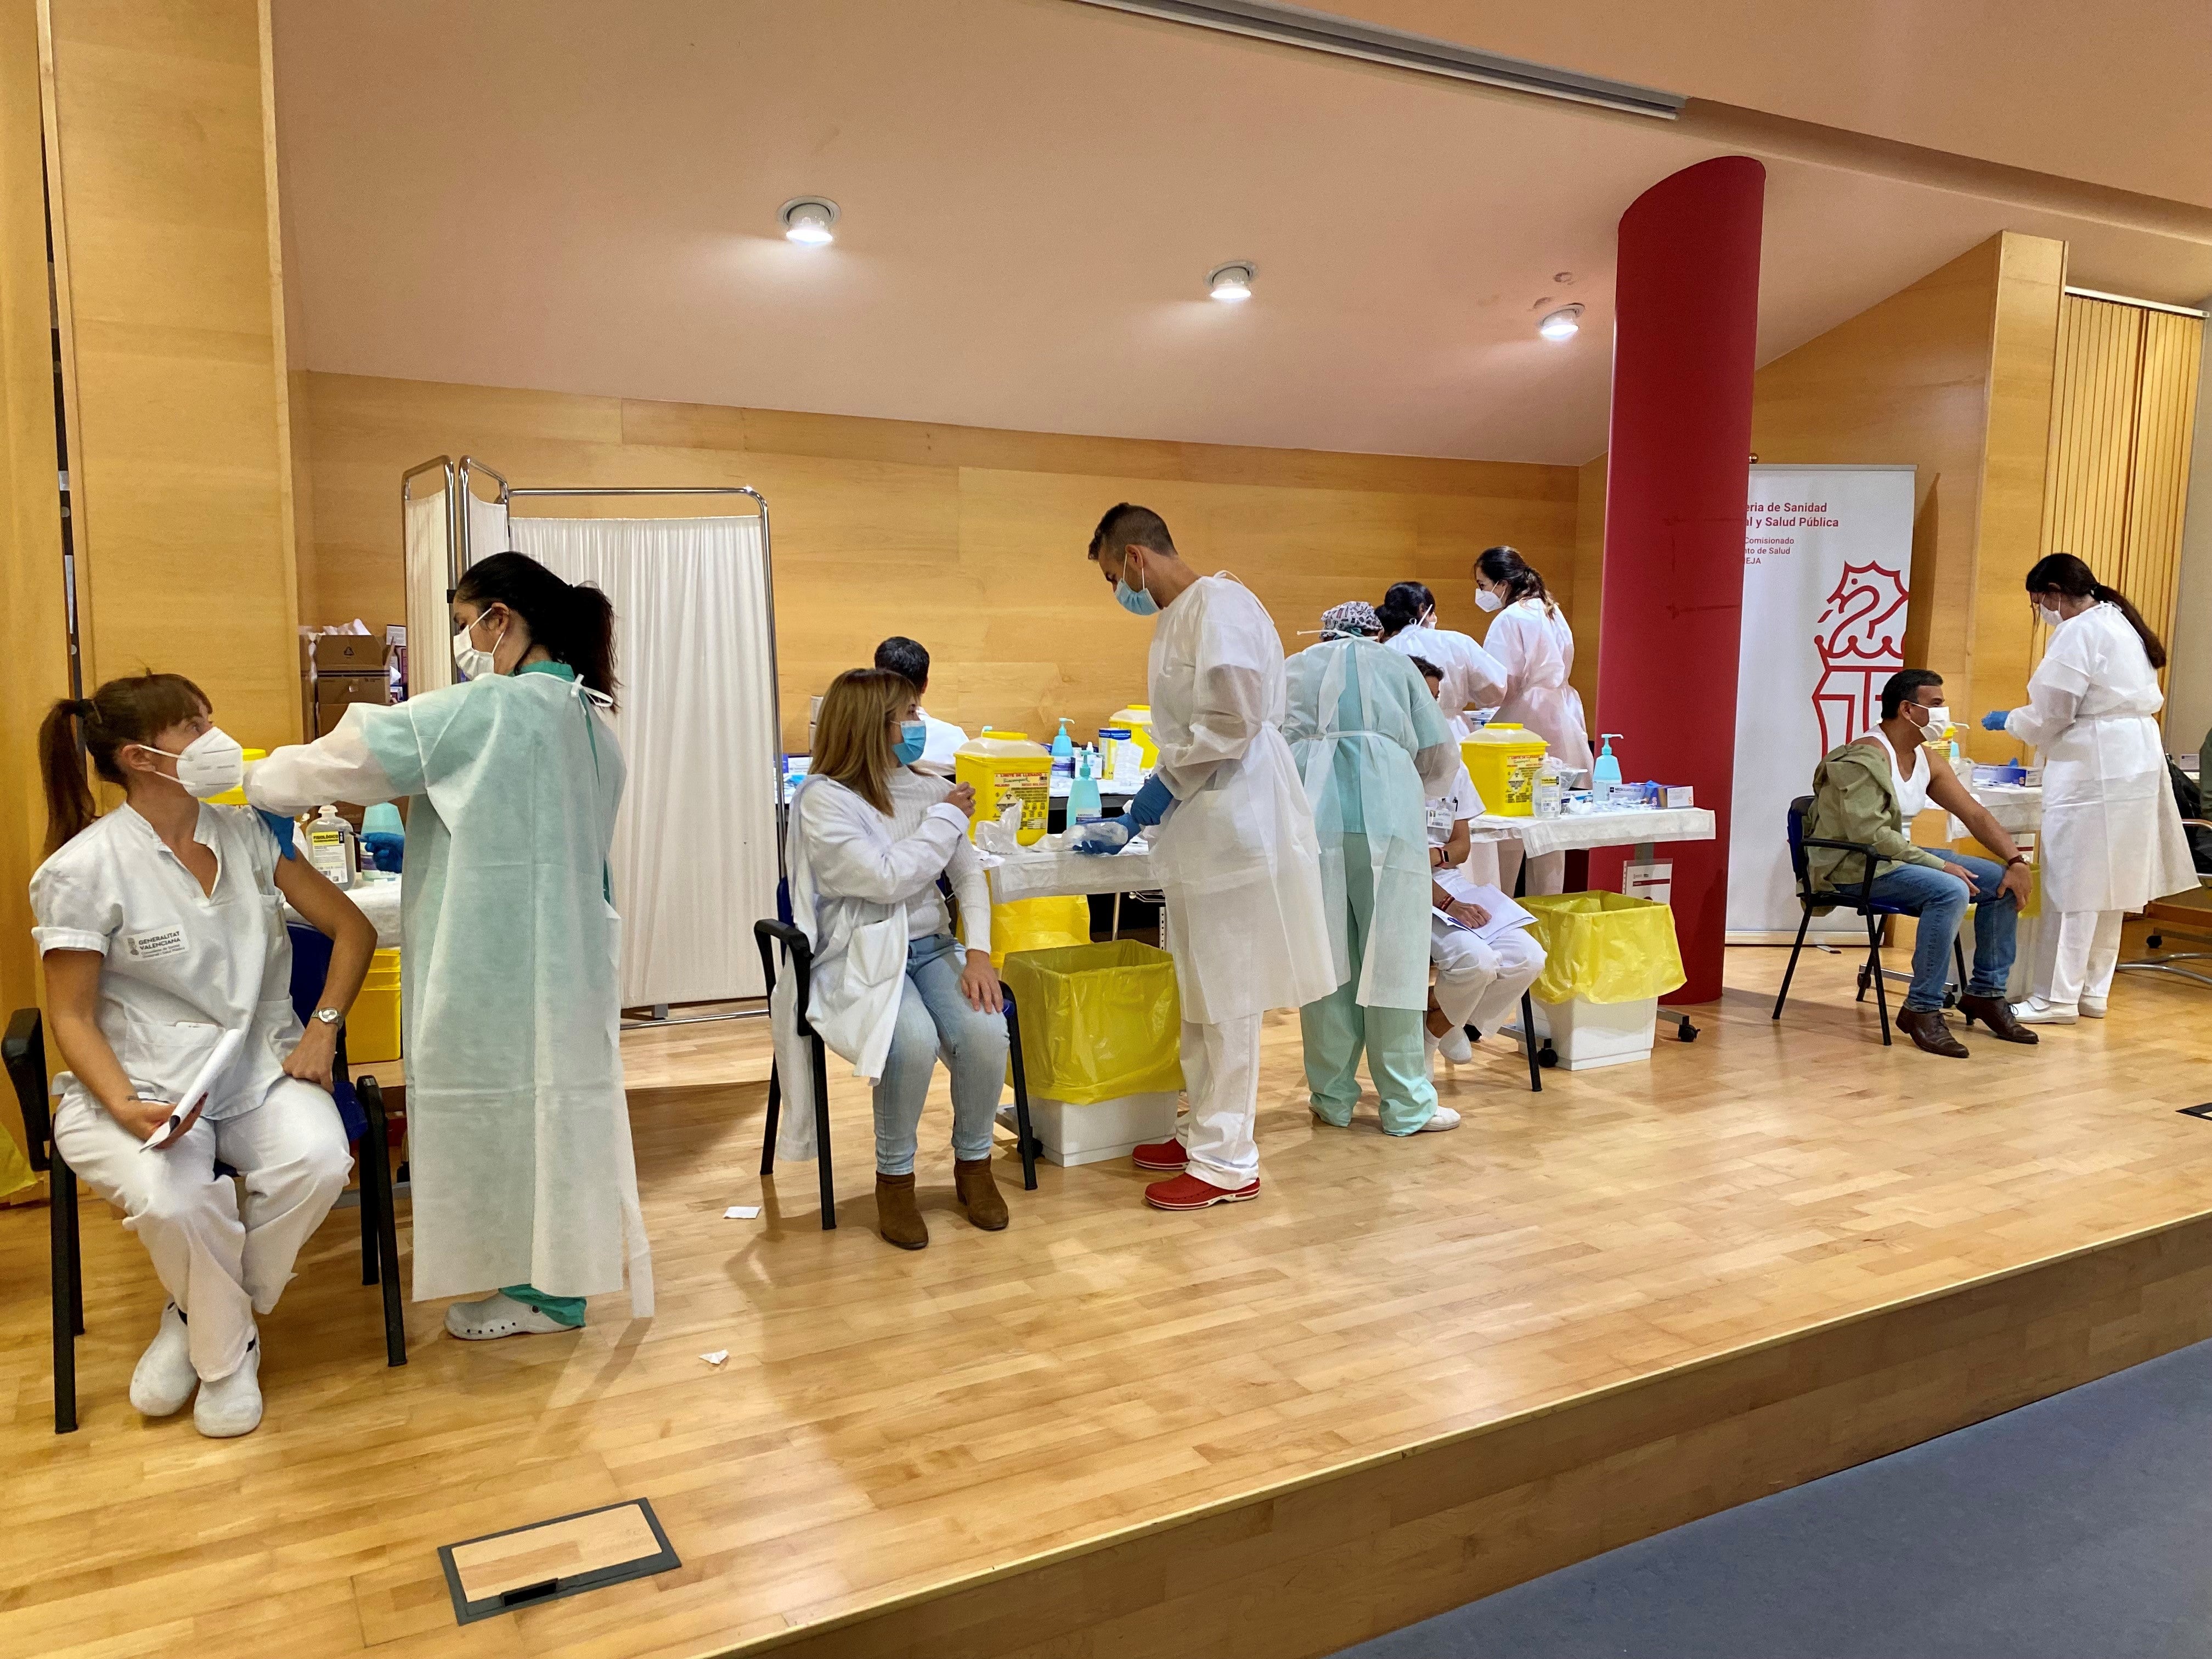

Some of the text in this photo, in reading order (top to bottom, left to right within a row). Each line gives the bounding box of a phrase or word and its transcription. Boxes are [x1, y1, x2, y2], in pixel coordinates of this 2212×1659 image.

[1768, 502, 1780, 512] de
[1784, 502, 1827, 512] Sanidad
[1756, 519, 1762, 528] y
[1765, 517, 1796, 527] Salud
[1799, 517, 1839, 527] Pública
[138, 931, 179, 945] GENERALITAT
[139, 938, 181, 950] VALENCIANA
